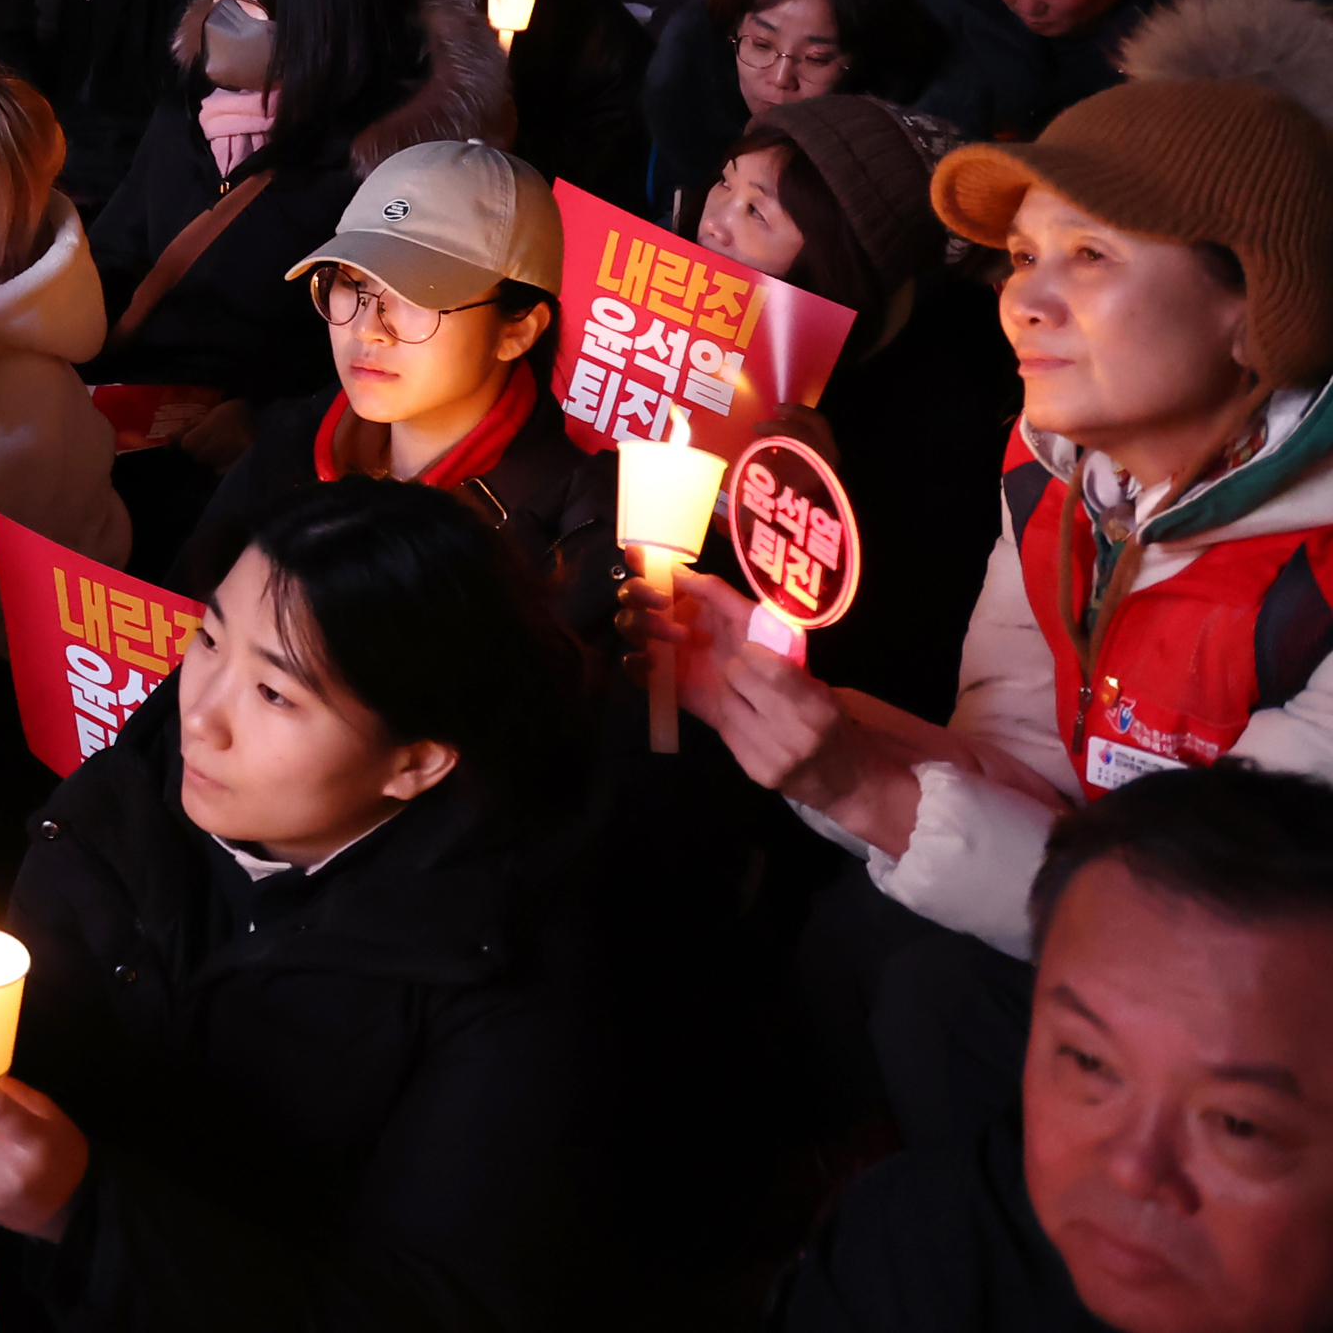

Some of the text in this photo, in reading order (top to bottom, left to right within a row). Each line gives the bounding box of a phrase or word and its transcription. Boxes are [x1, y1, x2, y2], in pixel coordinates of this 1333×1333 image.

[595, 229, 771, 350] 내란죄
[580, 296, 746, 417] 윤석열
[741, 463, 843, 571] 윤석열
[749, 518, 824, 612] 퇴진
